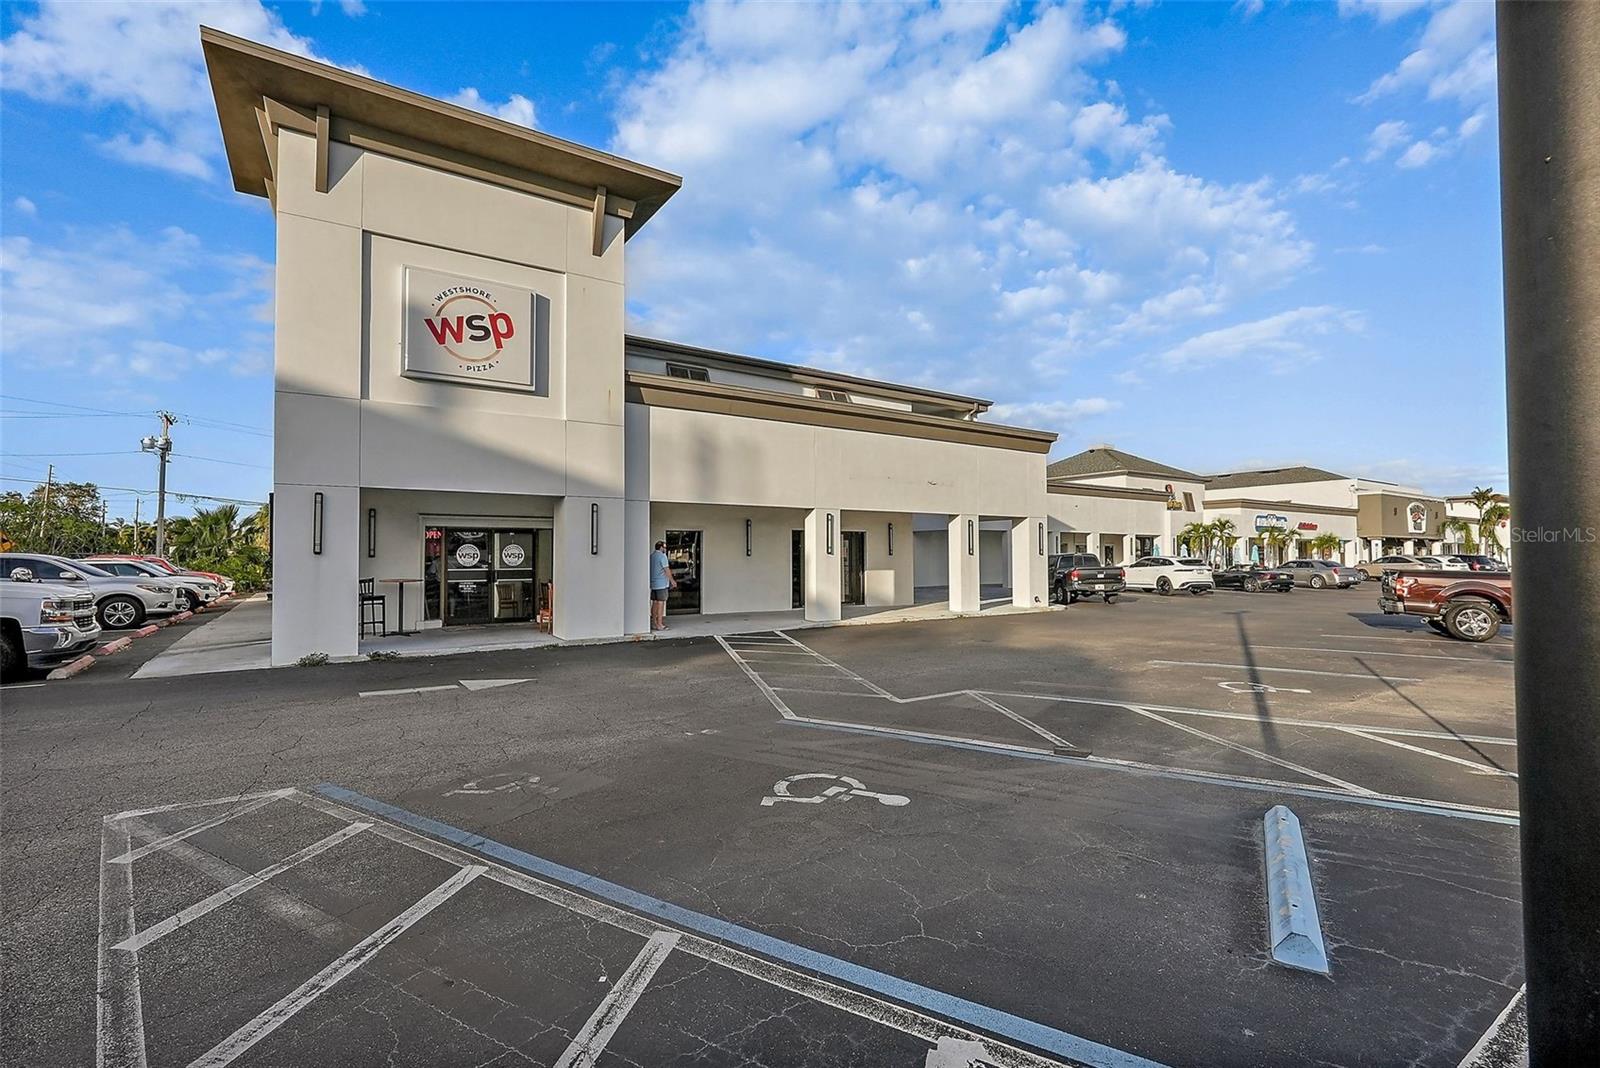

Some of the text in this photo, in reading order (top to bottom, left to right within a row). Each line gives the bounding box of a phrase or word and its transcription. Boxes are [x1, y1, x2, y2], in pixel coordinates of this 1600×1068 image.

[434, 286, 492, 303] WESTSHORE
[424, 312, 515, 350] wsp
[466, 363, 495, 372] PIZZA
